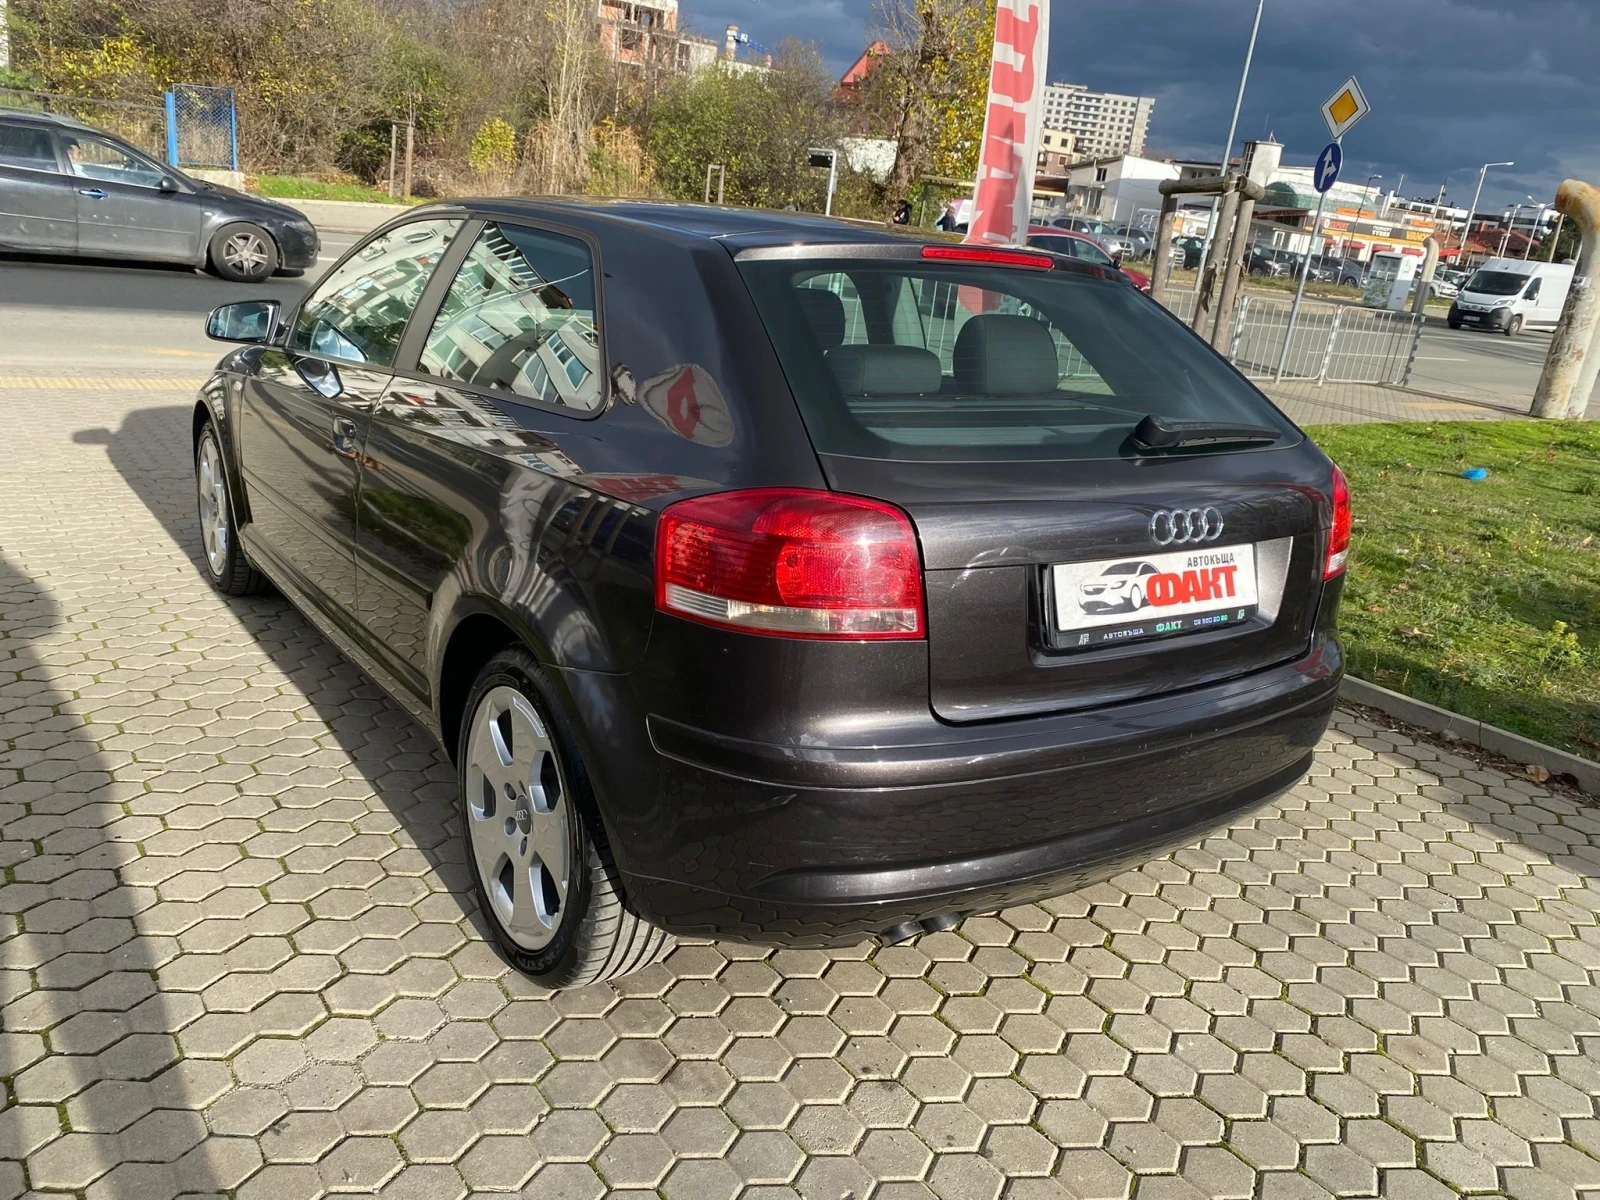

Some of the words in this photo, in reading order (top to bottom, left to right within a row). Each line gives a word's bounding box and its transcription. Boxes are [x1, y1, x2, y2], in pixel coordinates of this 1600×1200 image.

[1187, 552, 1234, 568] АВТОКЪЩА
[1146, 565, 1237, 607] ФАКТ
[1156, 620, 1183, 632] ФАКТ
